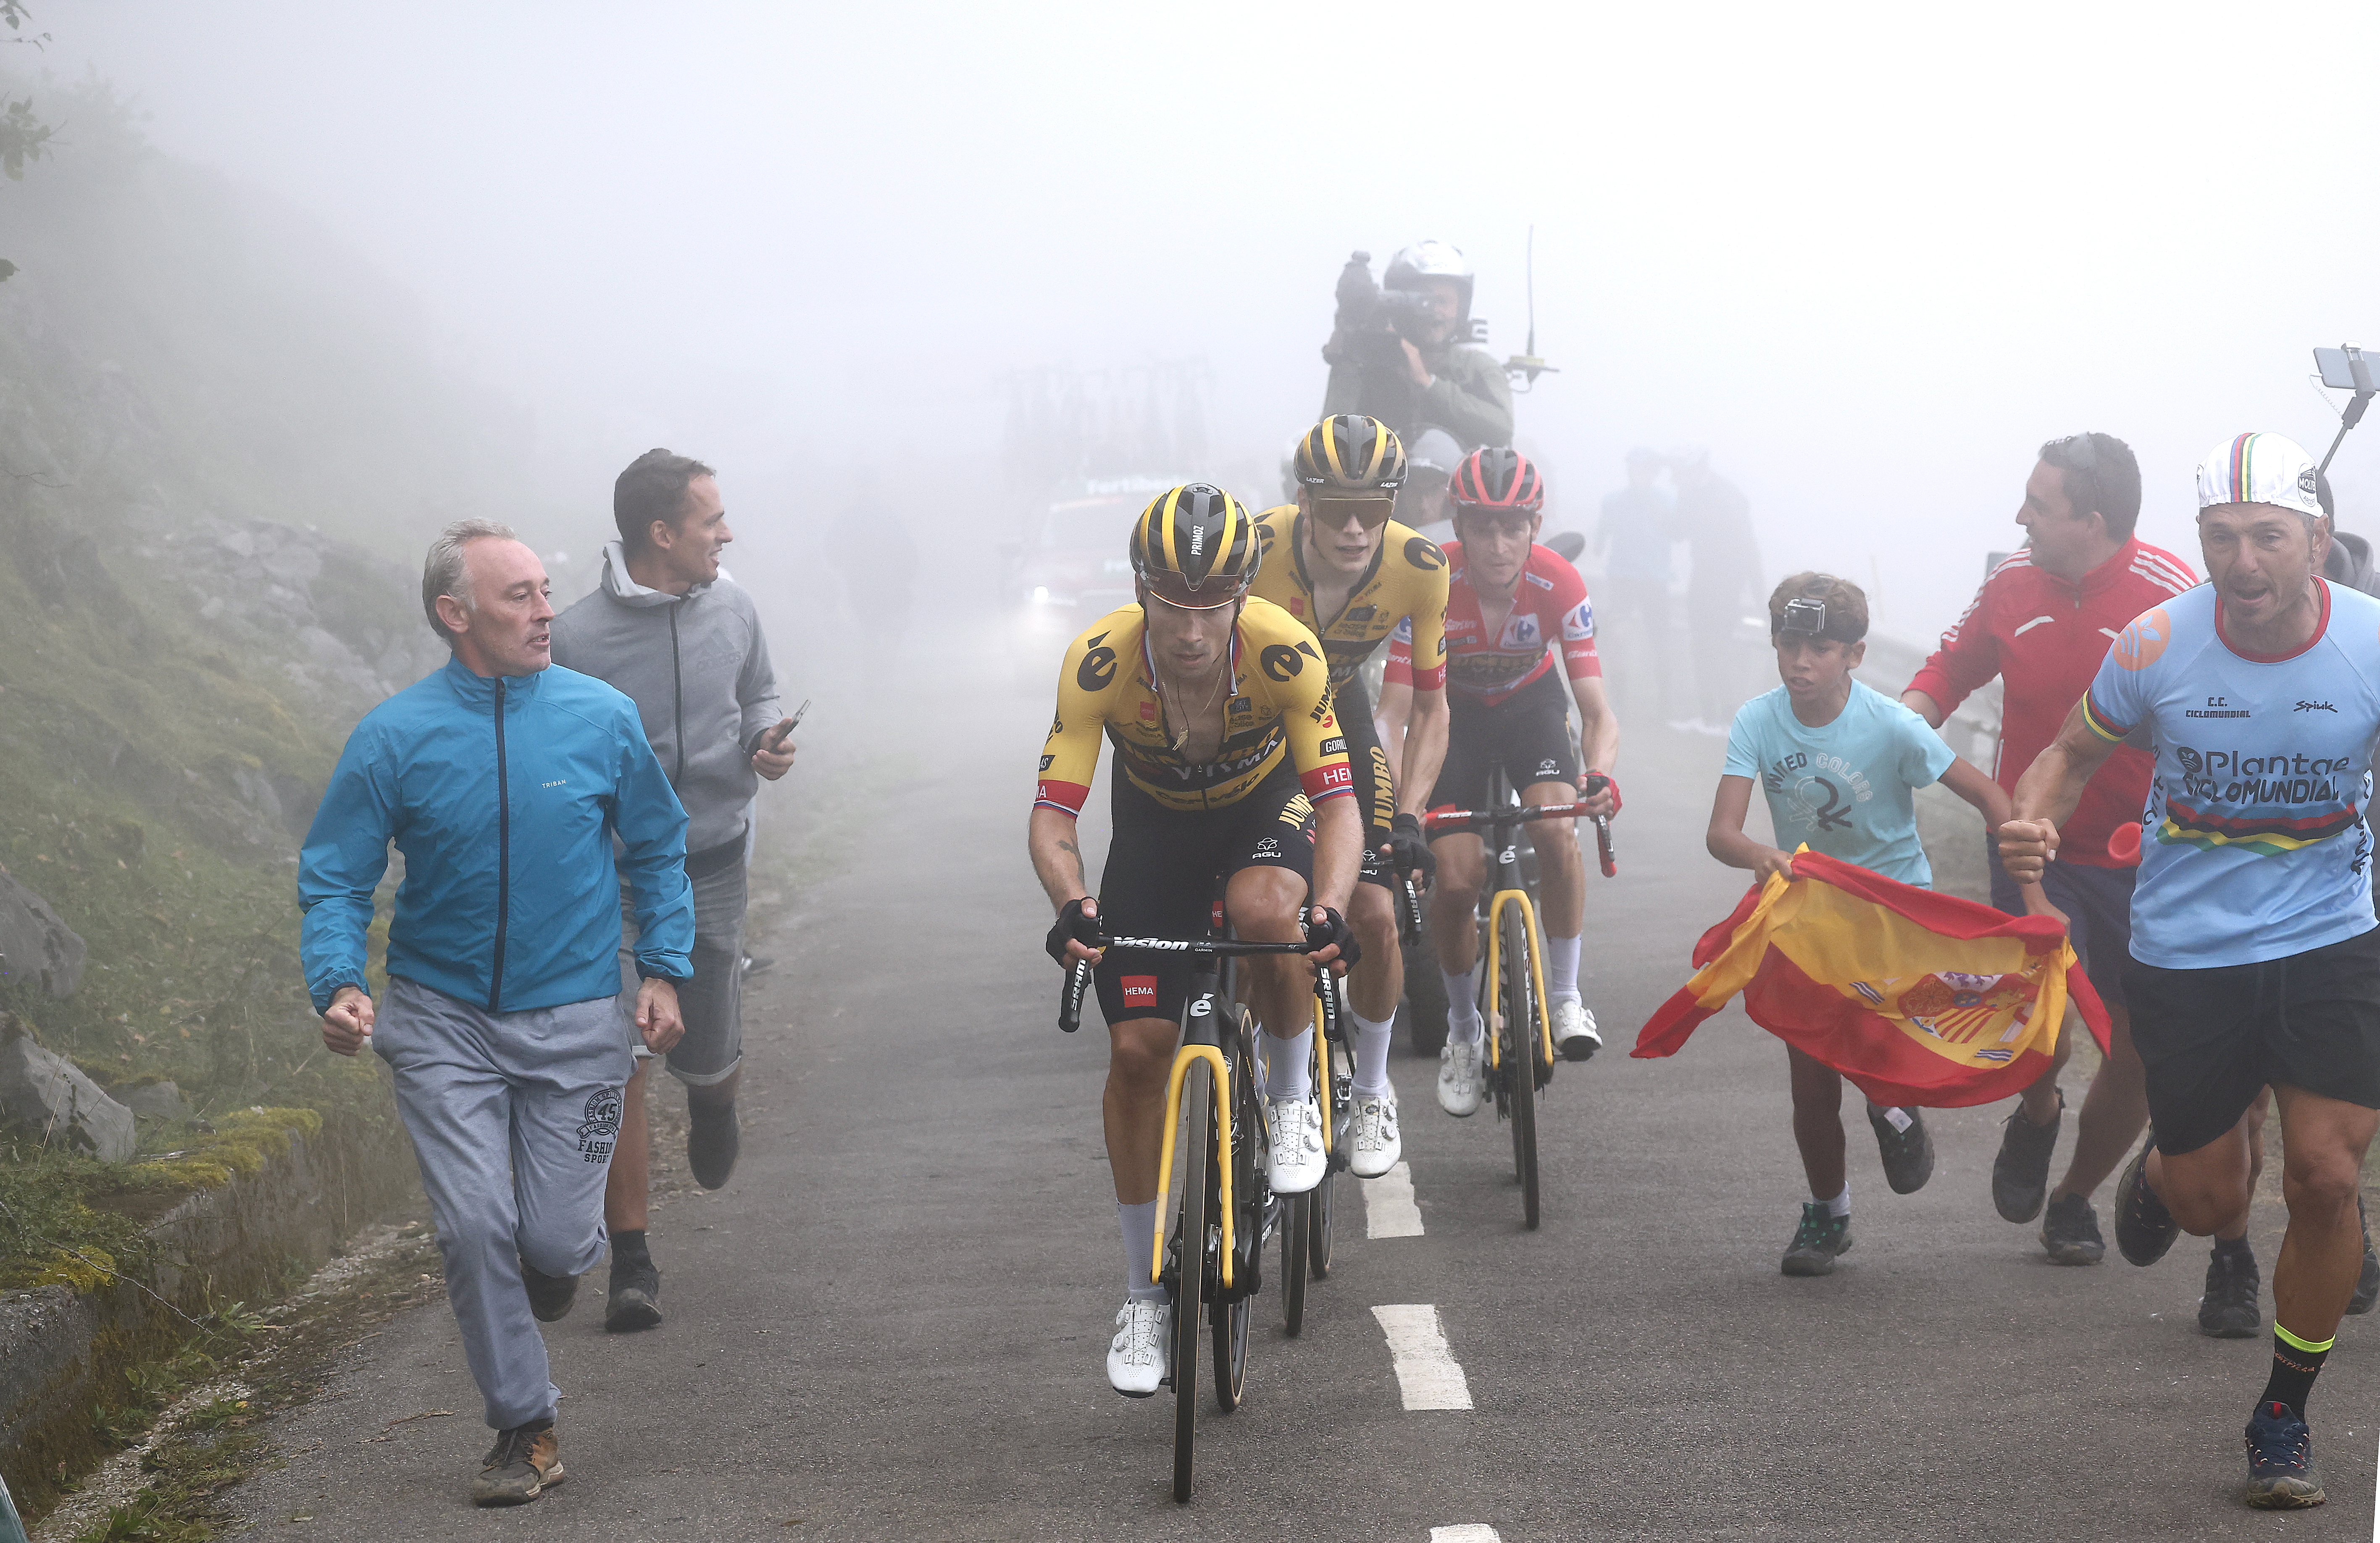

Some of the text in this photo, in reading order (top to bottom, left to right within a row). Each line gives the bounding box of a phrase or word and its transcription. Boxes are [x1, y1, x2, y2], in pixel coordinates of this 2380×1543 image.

[2298, 477, 2316, 492] MOLTE
[1190, 525, 1204, 556] PRIMOZ
[2208, 696, 2228, 707] C.C.
[2293, 700, 2338, 713] Spiuk
[2185, 709, 2251, 718] CICLOMUNDIAL
[1325, 738, 1347, 753] GORILL
[1766, 752, 1808, 794] UNITED
[2206, 750, 2350, 777] Plantae
[542, 779, 566, 789] TRIBAN
[1816, 753, 1873, 802] COLORS
[1370, 746, 1395, 832] JUMBO
[1278, 788, 1315, 831] JUMB
[1405, 880, 1422, 924] SRAM
[1070, 958, 1087, 1011] SRAM
[1125, 987, 1154, 996] HEMA
[1320, 967, 1336, 1020] SRAM
[1189, 993, 1215, 1017] é
[597, 1103, 617, 1122] 45
[578, 1139, 613, 1154] FASHIO
[584, 1153, 609, 1164] SPOR
[1261, 1223, 1272, 1245] AM
